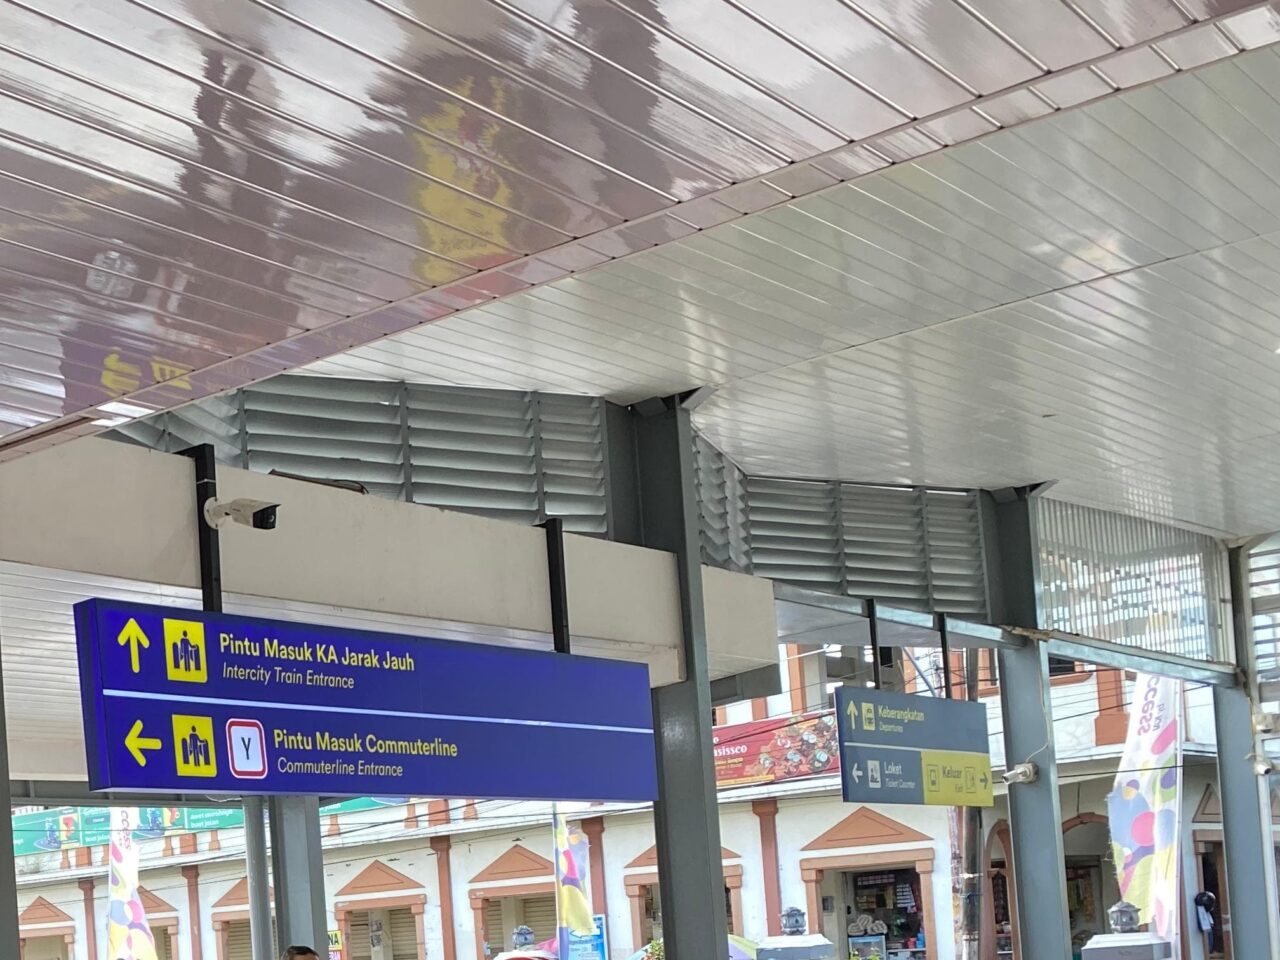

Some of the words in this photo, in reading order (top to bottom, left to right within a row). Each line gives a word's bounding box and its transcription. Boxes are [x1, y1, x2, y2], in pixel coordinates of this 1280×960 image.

[219, 633, 260, 657] Pintu
[264, 637, 313, 662] Masuk
[316, 643, 339, 664] KA
[341, 647, 380, 668] Jarak
[383, 650, 415, 671] Jauh
[223, 662, 271, 685] Intercity
[274, 667, 303, 685] Train
[306, 669, 355, 688] Entrance
[878, 704, 925, 723] Keberangkatan
[241, 737, 251, 760] Y
[273, 729, 312, 750] Pintu
[316, 731, 363, 752] Masuk
[366, 734, 458, 757] Commuterline
[277, 757, 355, 776] Commuterline
[358, 760, 404, 777] Entrance
[884, 761, 902, 775] Loket
